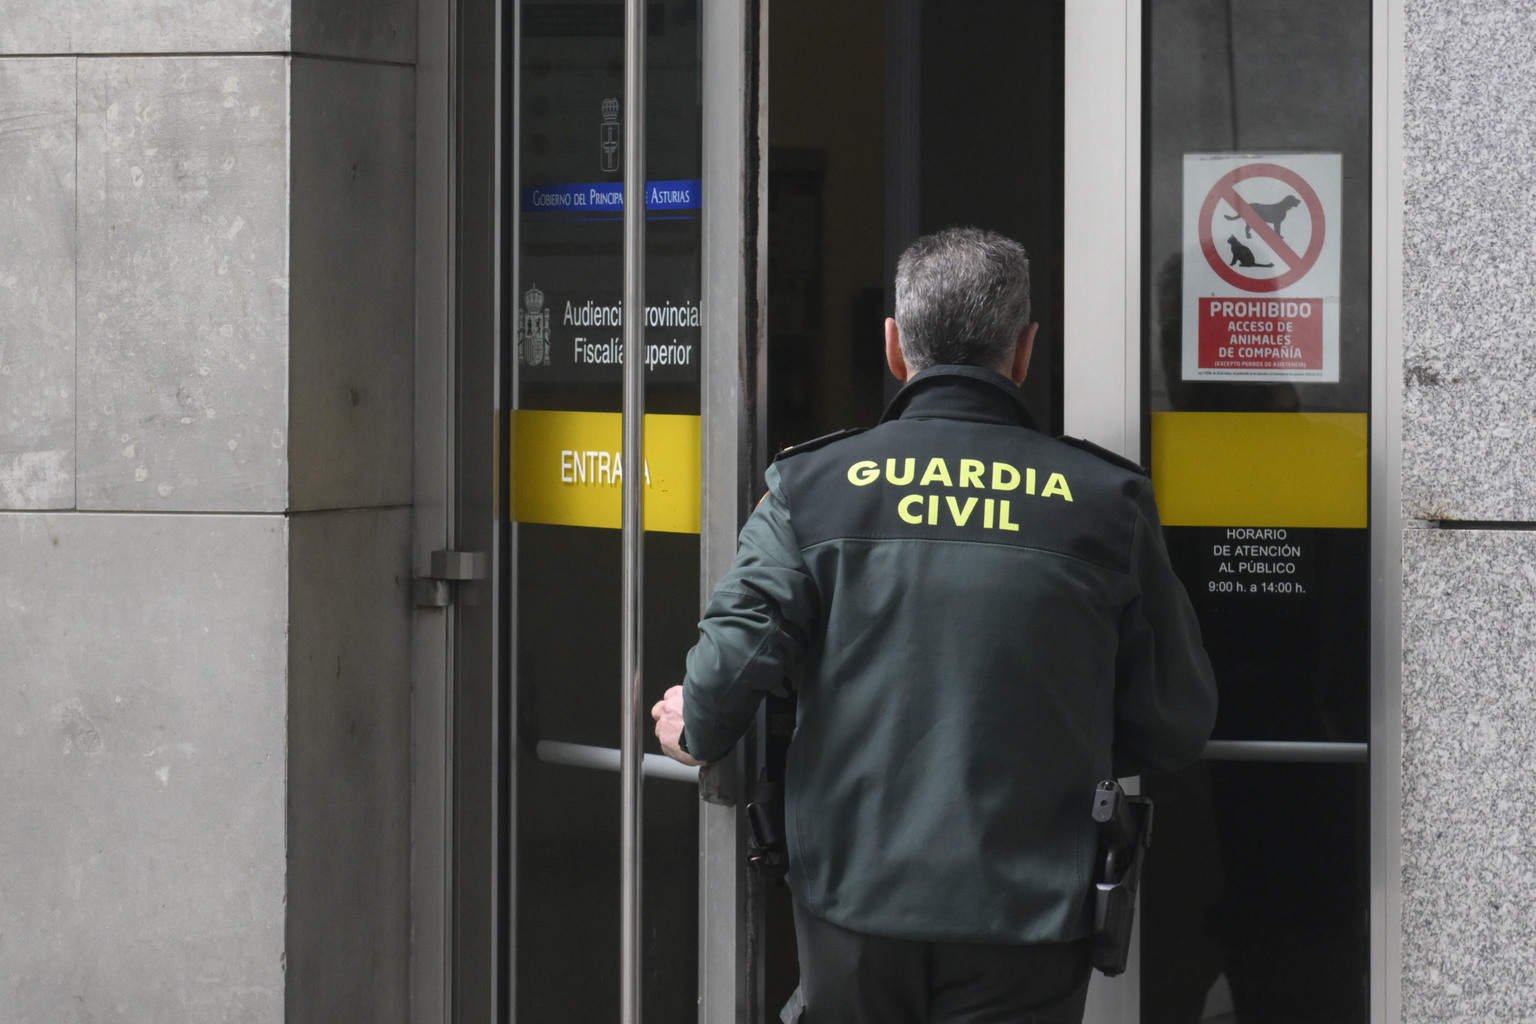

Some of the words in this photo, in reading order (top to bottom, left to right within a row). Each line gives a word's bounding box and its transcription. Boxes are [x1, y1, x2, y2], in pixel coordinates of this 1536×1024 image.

[590, 189, 623, 205] PRINCIPA
[651, 187, 690, 204] ASTURIAS
[563, 300, 622, 326] Audienci
[645, 300, 702, 327] rovincial
[1210, 301, 1312, 318] PROHIBIDO
[1228, 321, 1273, 332] ACCESO
[1277, 321, 1293, 332] DE
[1229, 334, 1291, 345] ANIMALES
[645, 339, 692, 371] uperior
[1219, 347, 1234, 358] DE
[1238, 345, 1302, 358] COMPAÑÍA
[561, 450, 651, 484] ENTRA
[847, 457, 1073, 502] GUARDIA
[897, 494, 1019, 531] CIVIL
[1227, 529, 1287, 540] HORARIO
[1213, 545, 1231, 556] DE
[1235, 544, 1301, 557] ATENCIÓN
[1219, 562, 1235, 573] AL
[1239, 560, 1296, 574] PÚBLICO
[1208, 581, 1233, 592] 9:00
[1236, 581, 1246, 592] h.
[1250, 584, 1257, 592] a
[1262, 582, 1292, 593] 14:00
[1296, 582, 1306, 593] h.
